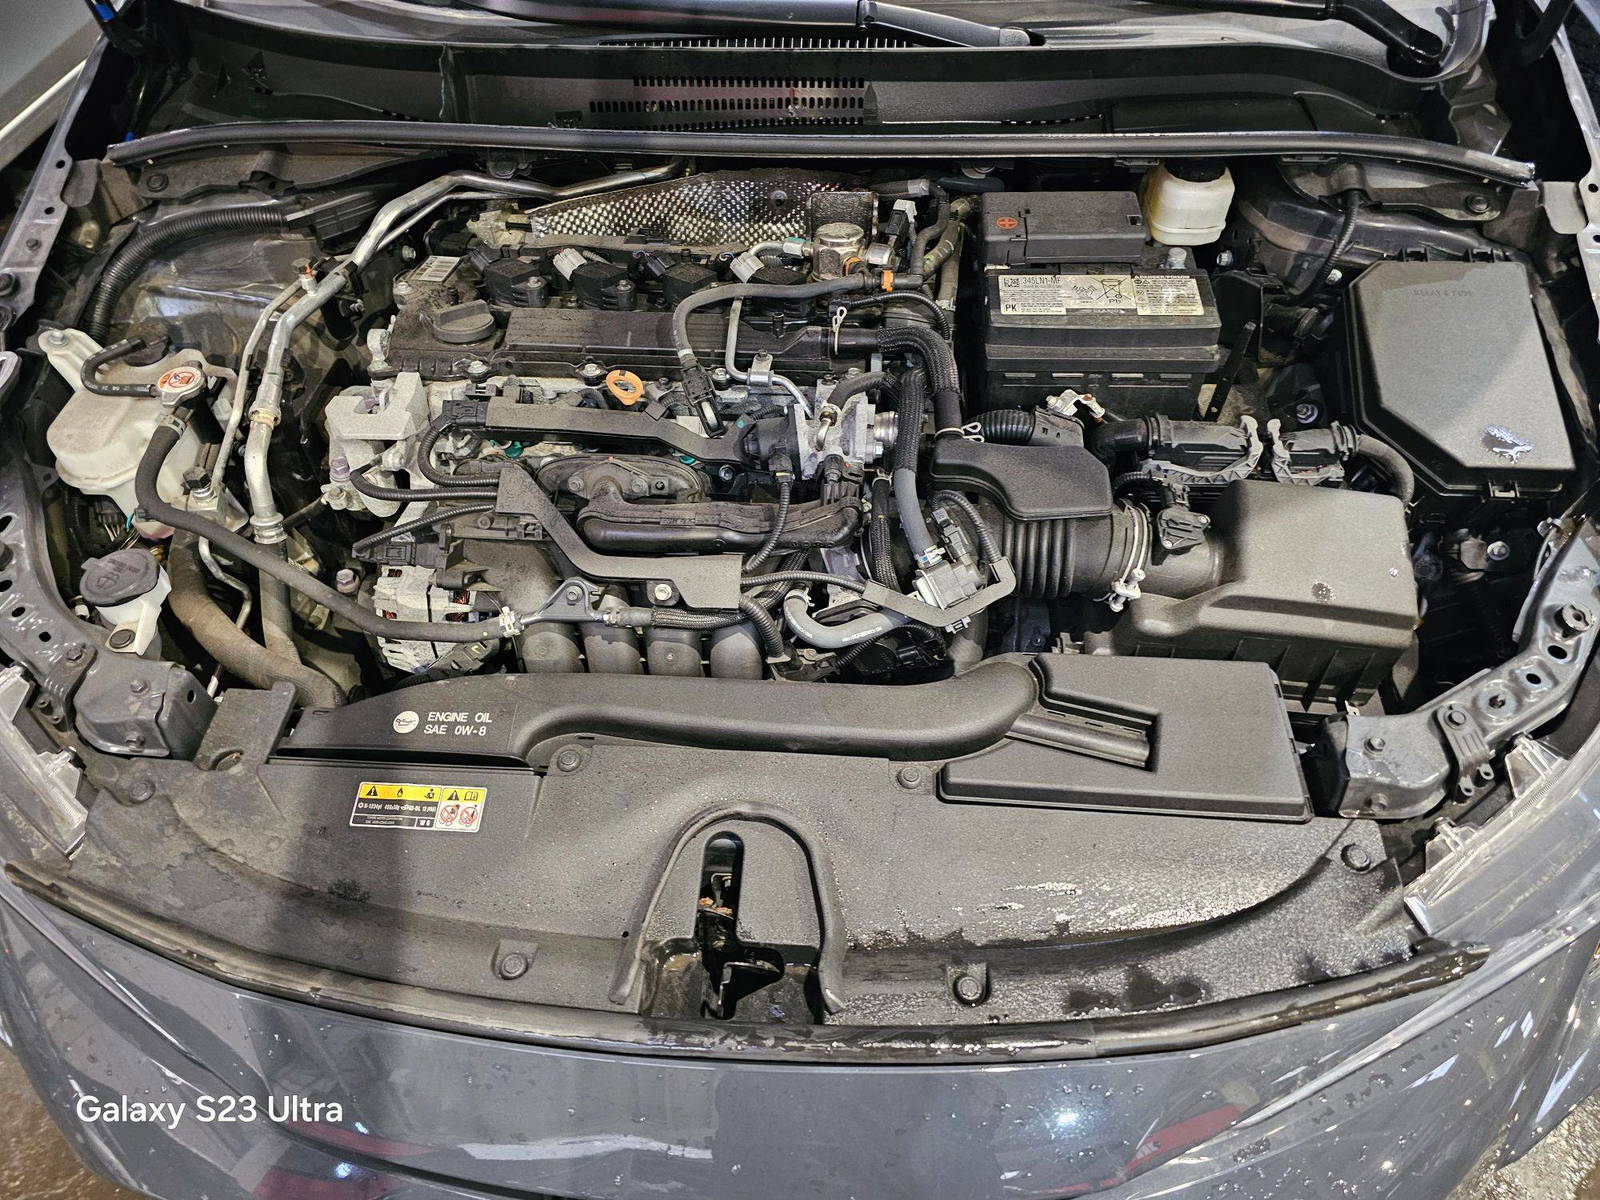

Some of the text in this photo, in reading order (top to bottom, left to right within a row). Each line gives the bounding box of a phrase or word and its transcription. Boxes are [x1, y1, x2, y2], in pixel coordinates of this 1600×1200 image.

[1005, 304, 1017, 312] PK
[427, 711, 493, 723] ENGINE OIL
[423, 724, 487, 736] SAE 0W-8
